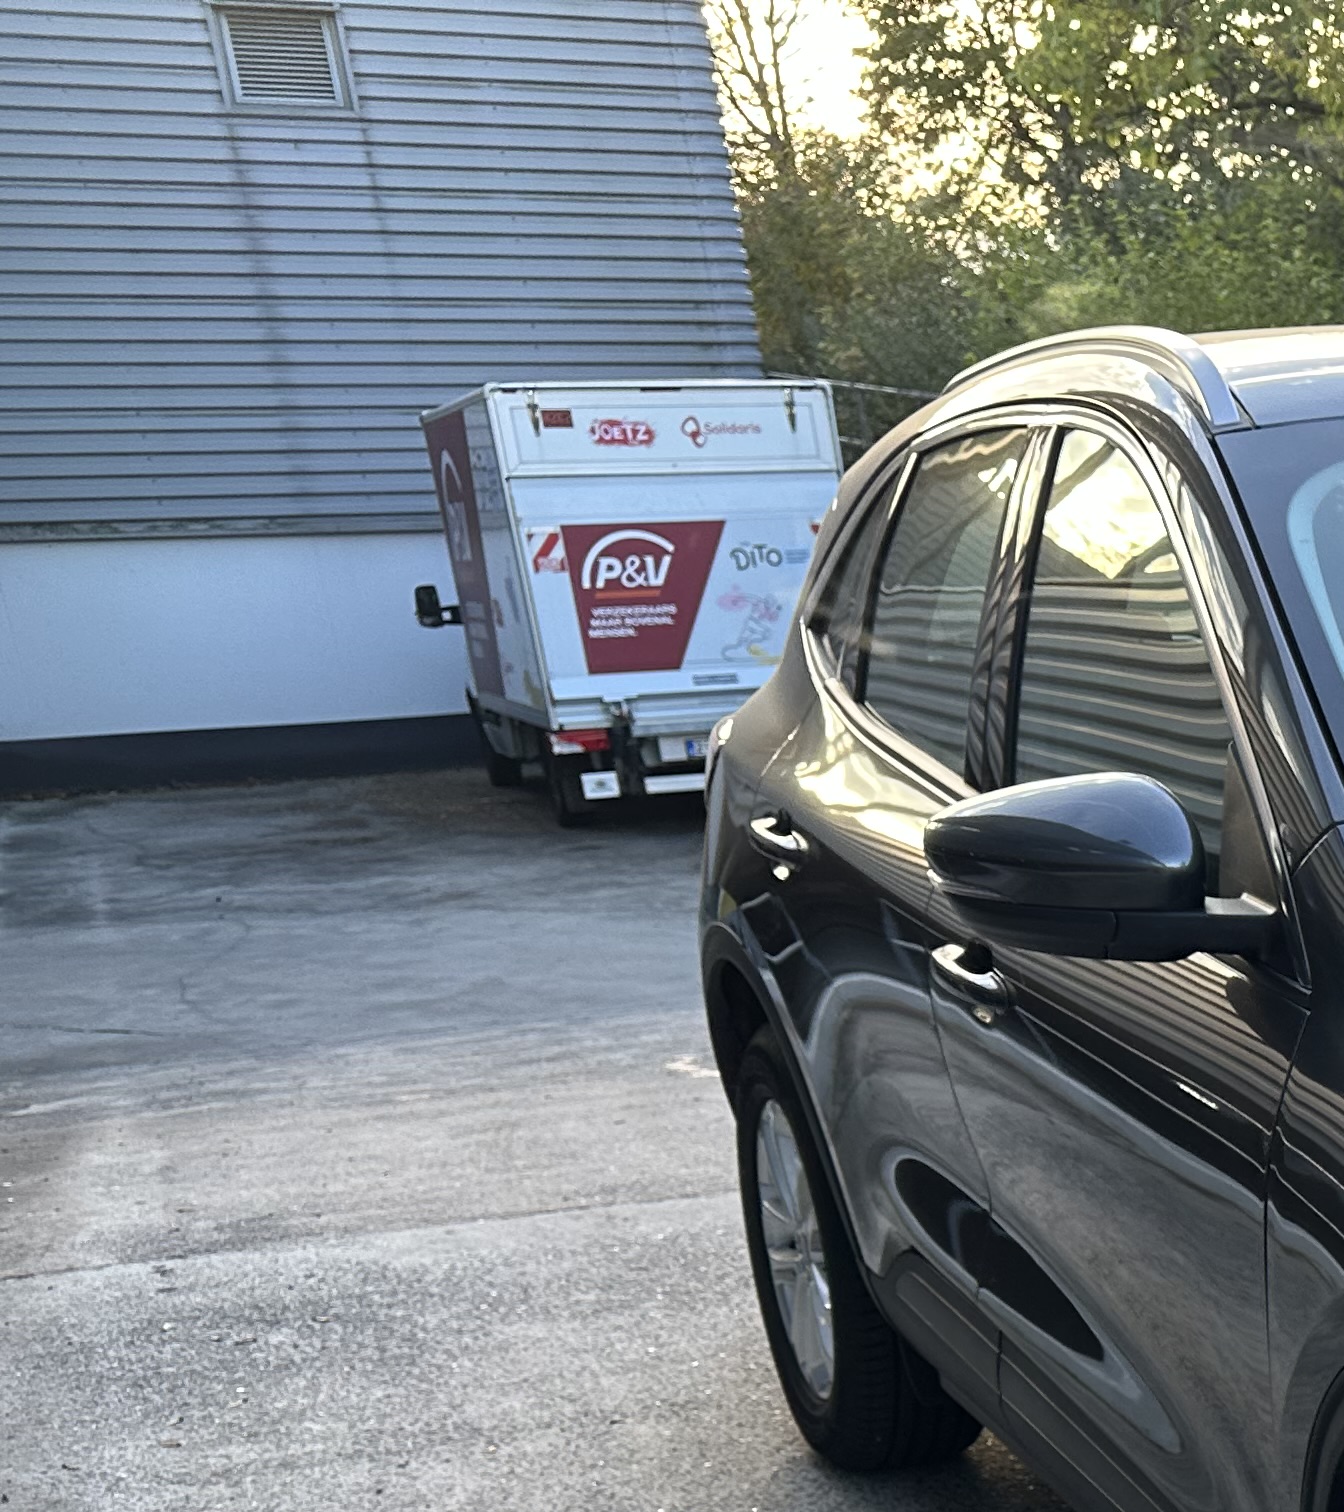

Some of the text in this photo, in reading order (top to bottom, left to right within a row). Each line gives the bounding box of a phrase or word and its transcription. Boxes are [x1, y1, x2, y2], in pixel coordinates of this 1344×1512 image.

[591, 423, 649, 444] JOETZ
[704, 421, 762, 435] Solidaris
[595, 554, 673, 590] P&V
